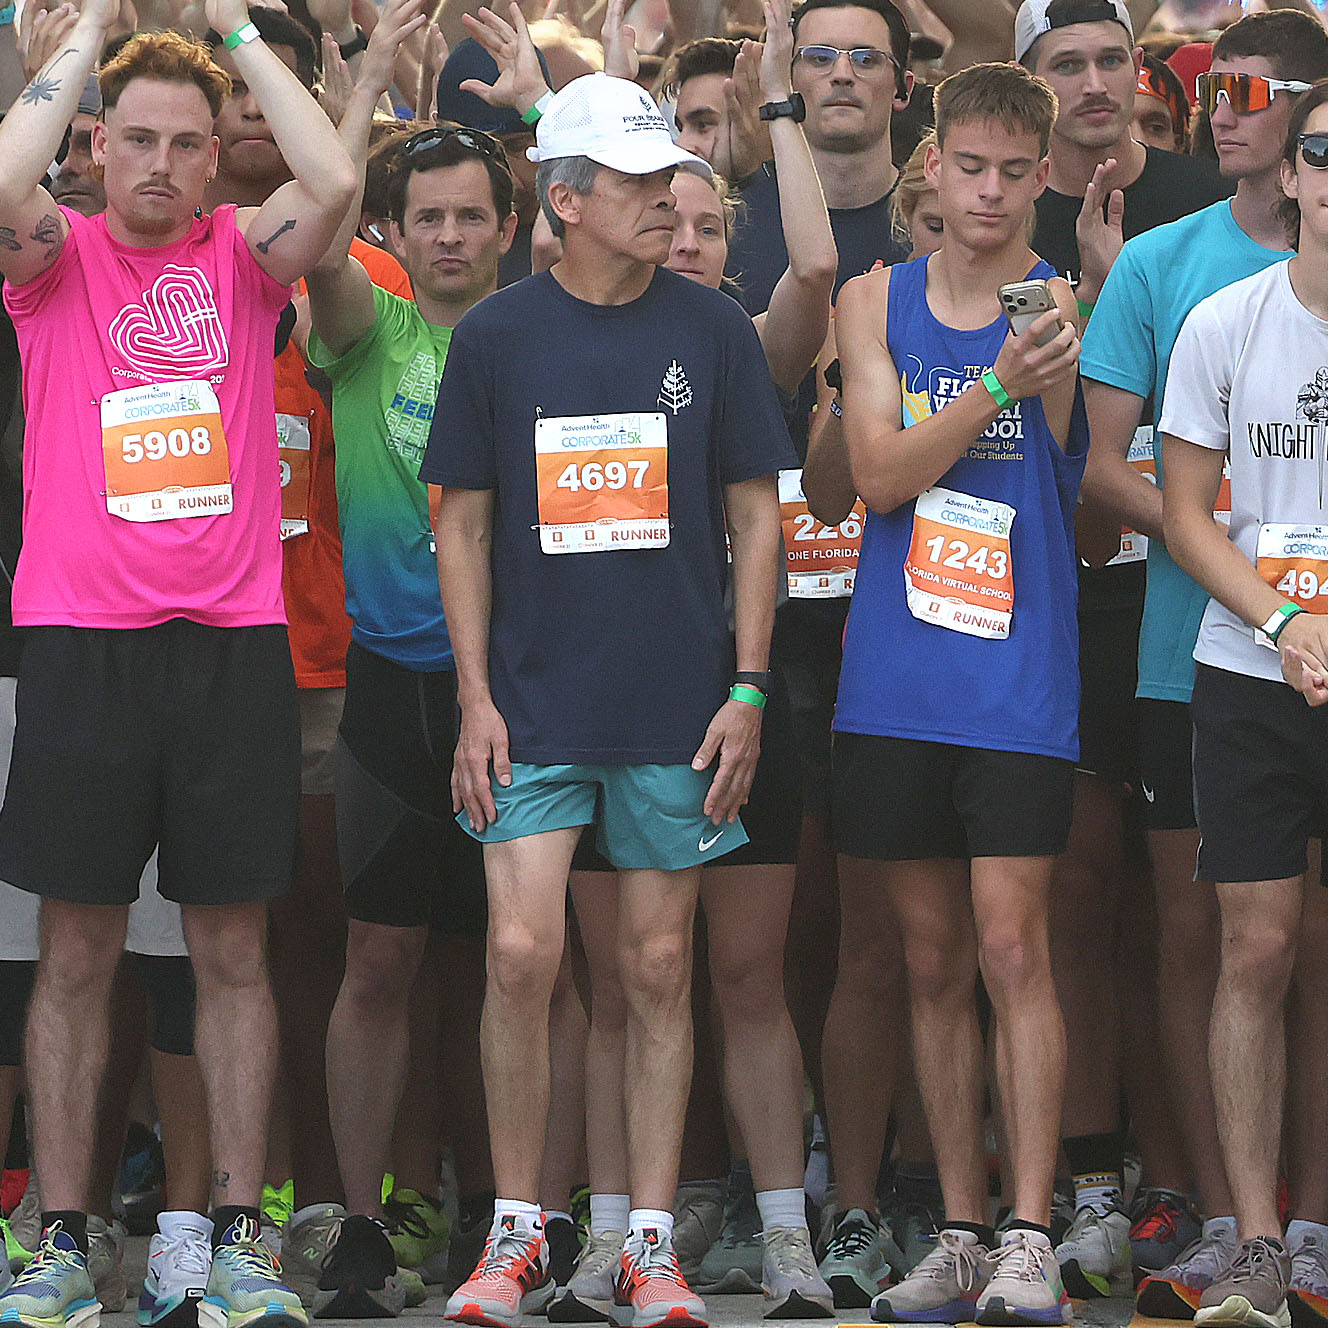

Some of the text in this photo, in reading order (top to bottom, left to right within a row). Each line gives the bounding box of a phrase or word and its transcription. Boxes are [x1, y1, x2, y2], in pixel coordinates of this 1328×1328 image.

[125, 400, 188, 419] CORPORATE
[122, 426, 212, 463] 5908
[561, 433, 627, 448] CORPORATE
[1002, 441, 1015, 450] Up
[1248, 422, 1318, 460] KNIGHT
[970, 450, 987, 460] Our
[556, 460, 650, 492] 4697
[178, 494, 230, 509] RUNNER
[940, 509, 999, 534] CORPORATE
[611, 528, 667, 542] RUNNER
[787, 548, 860, 561] ONE FLORIDA
[926, 535, 1008, 580] 1243
[941, 576, 979, 594] VIRTUAL
[979, 585, 1013, 601] SCHOOL
[953, 611, 1006, 633] RUNNER
